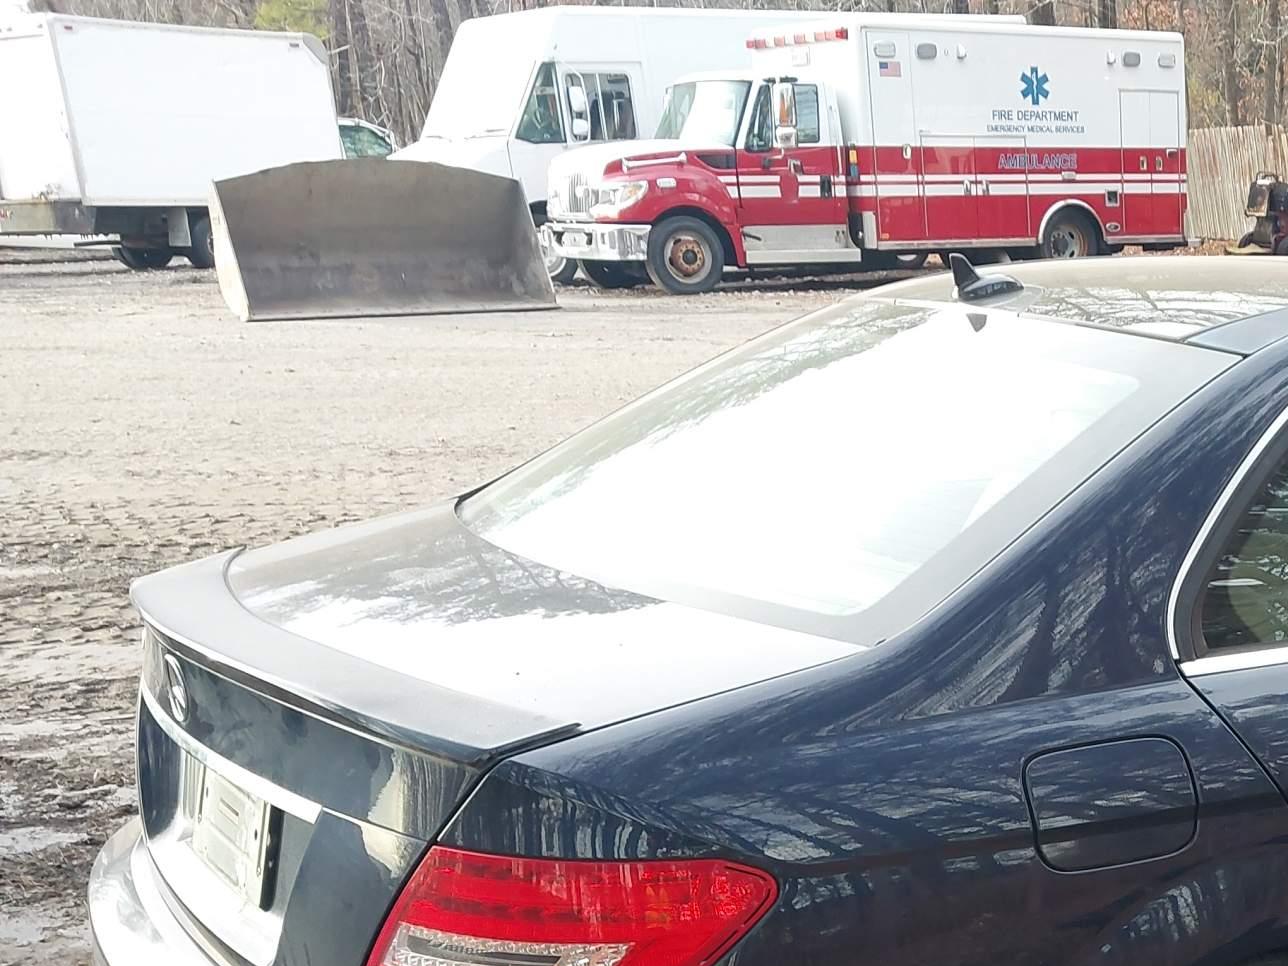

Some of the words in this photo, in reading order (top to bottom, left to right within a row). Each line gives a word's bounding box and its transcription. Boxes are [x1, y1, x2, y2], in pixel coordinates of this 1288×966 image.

[992, 110, 1013, 120] FIRE
[1017, 110, 1079, 122] DEPARTMENT
[987, 124, 1025, 132] EMERGENCY
[1027, 125, 1053, 133] MEDICAL
[1055, 125, 1085, 134] SERVICES
[998, 153, 1077, 169] AMBULANCE
